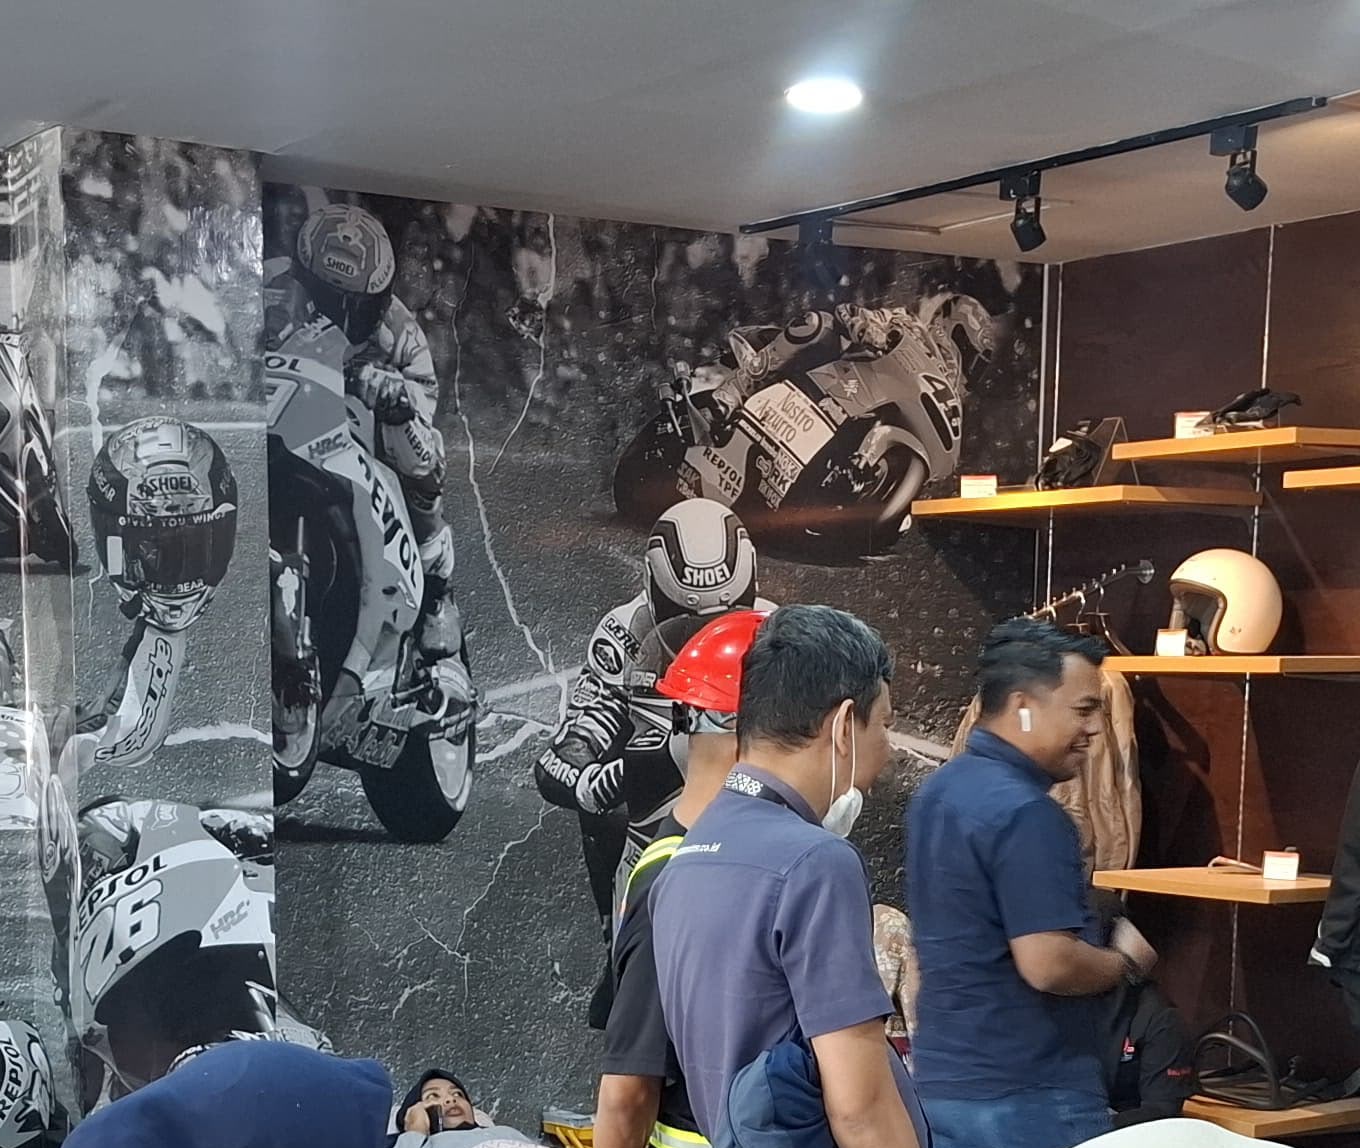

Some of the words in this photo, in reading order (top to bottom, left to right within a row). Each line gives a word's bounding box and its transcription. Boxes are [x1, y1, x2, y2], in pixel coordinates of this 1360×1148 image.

[702, 447, 743, 486] REPSOL
[148, 474, 193, 493] SHOEI
[769, 469, 792, 492] RK
[683, 562, 730, 587] SHOEI
[94, 637, 174, 762] alpinestars
